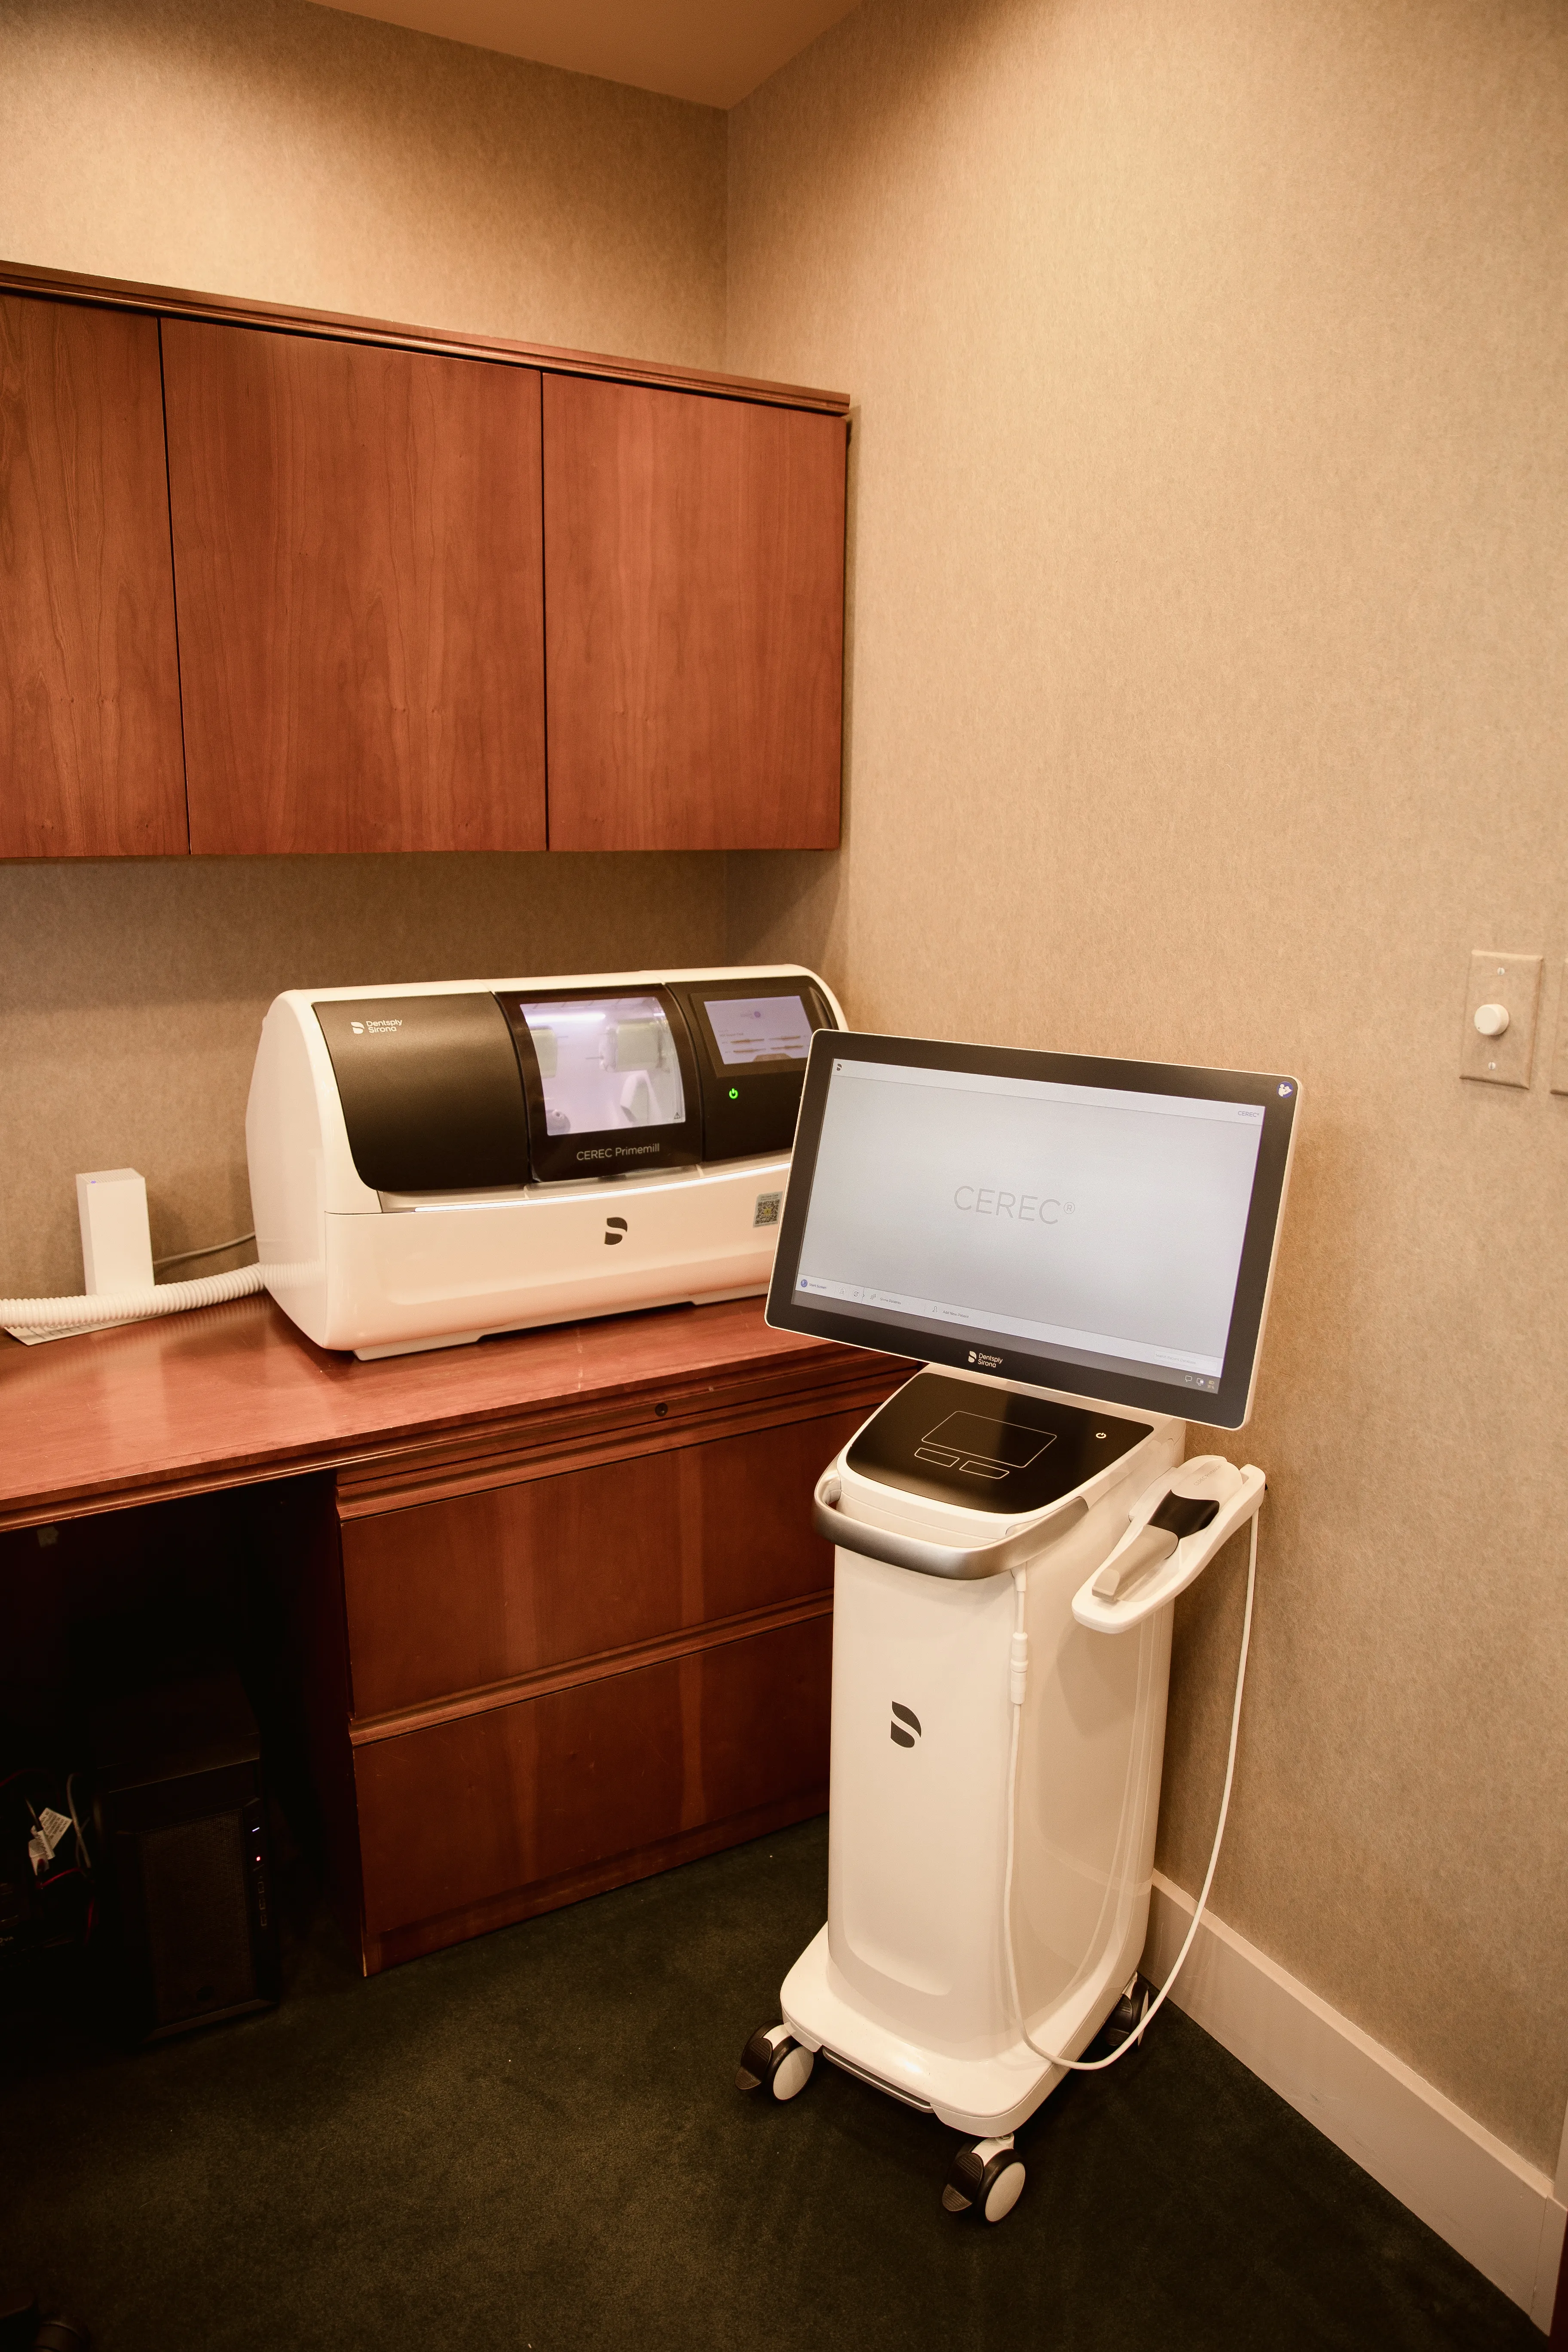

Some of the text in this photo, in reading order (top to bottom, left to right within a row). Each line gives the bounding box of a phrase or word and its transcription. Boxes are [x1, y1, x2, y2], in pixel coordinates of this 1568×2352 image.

[576, 1142, 660, 1161] CEREC Primemill
[977, 1359, 996, 1368] Sirona
[978, 1353, 1003, 1364] Dentsply
[1193, 1476, 1207, 1485] CEREC
